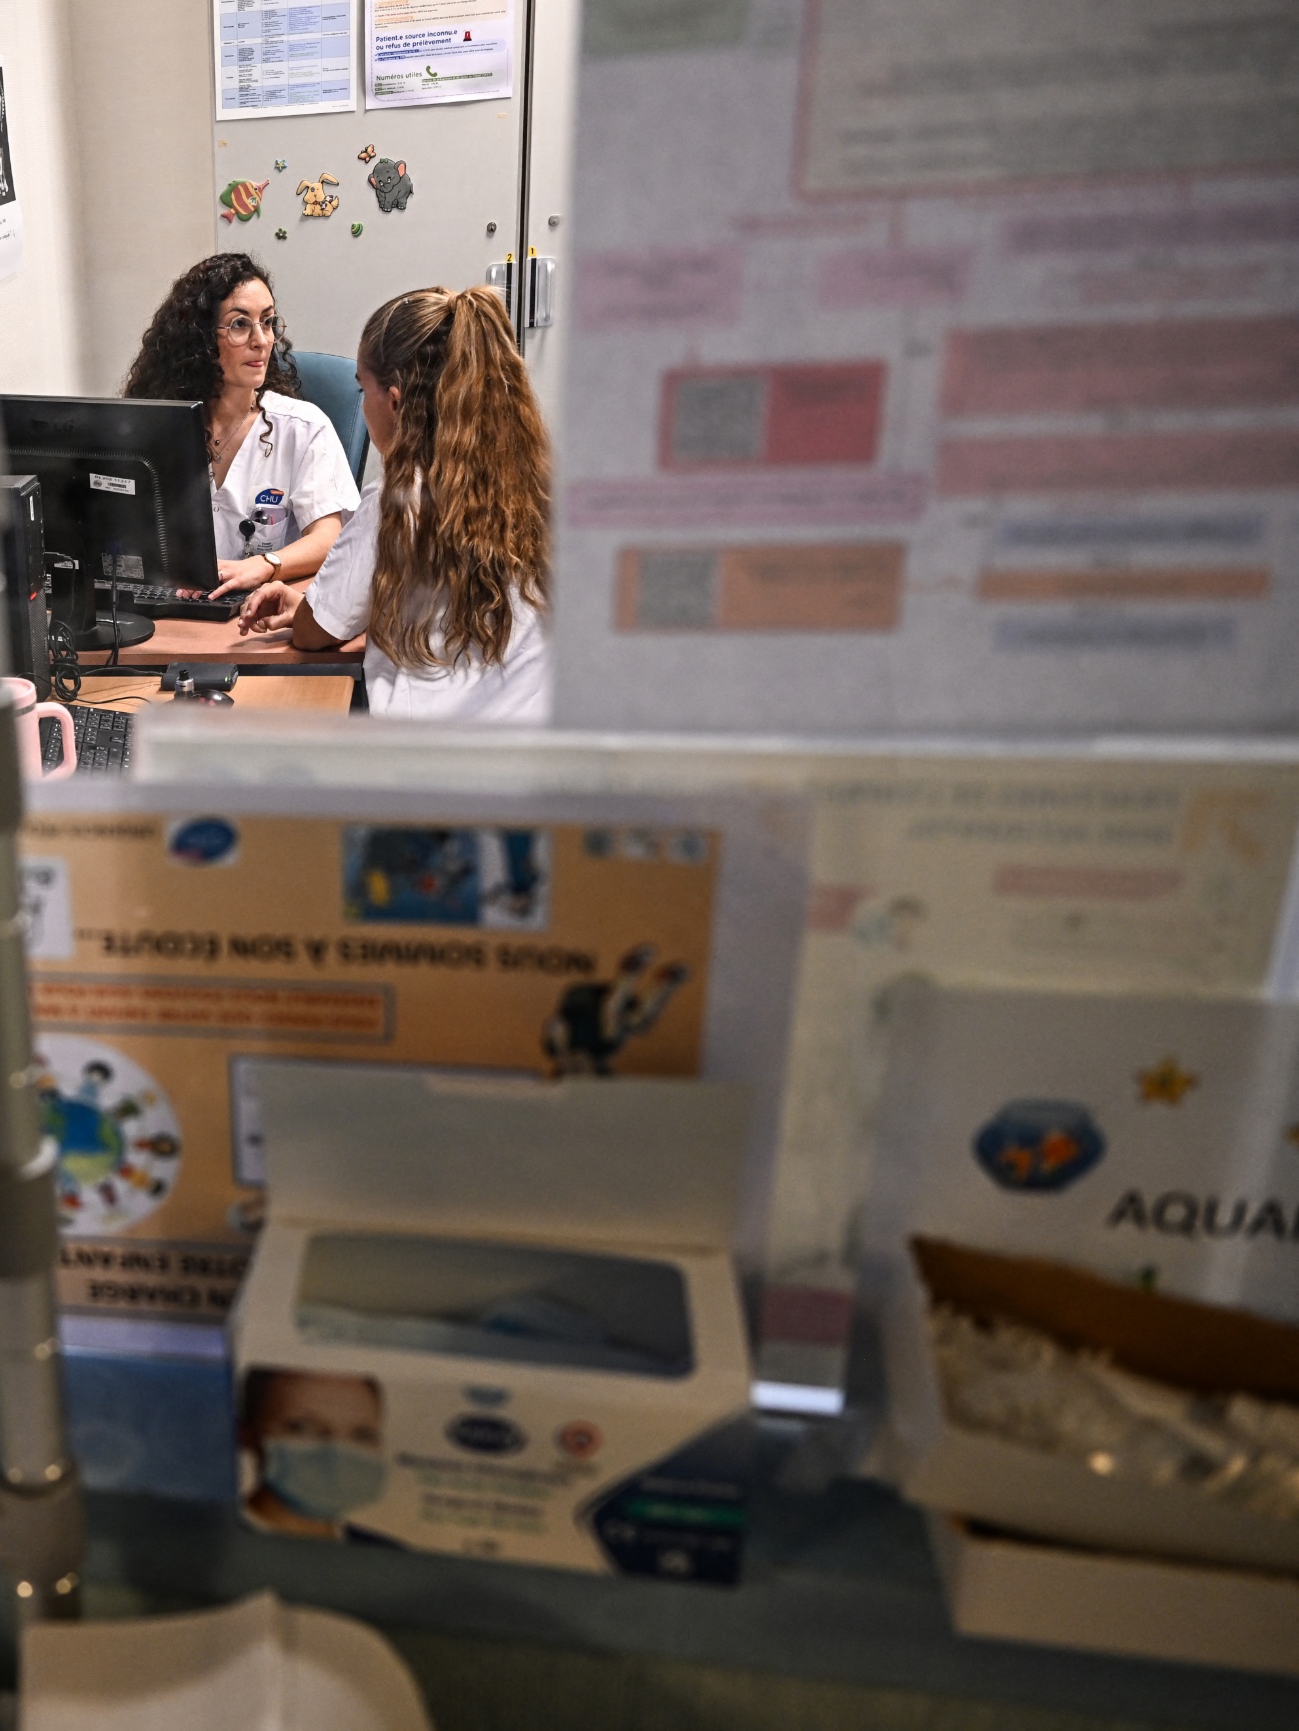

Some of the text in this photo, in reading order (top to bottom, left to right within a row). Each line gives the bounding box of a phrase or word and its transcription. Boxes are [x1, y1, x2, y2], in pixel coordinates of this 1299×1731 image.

[427, 29, 458, 38] inconnu.e
[412, 38, 451, 48] prélèvement
[376, 73, 404, 81] Numéros
[507, 253, 512, 262] 2
[530, 247, 534, 255] 1
[259, 494, 279, 503] CHU
[227, 931, 295, 963] SON
[338, 937, 486, 972] SOMMES
[495, 941, 594, 977] NOUS
[1105, 1186, 1299, 1243] AQUA
[59, 1248, 171, 1273] ENFANT
[89, 1279, 201, 1306] CHARGE
